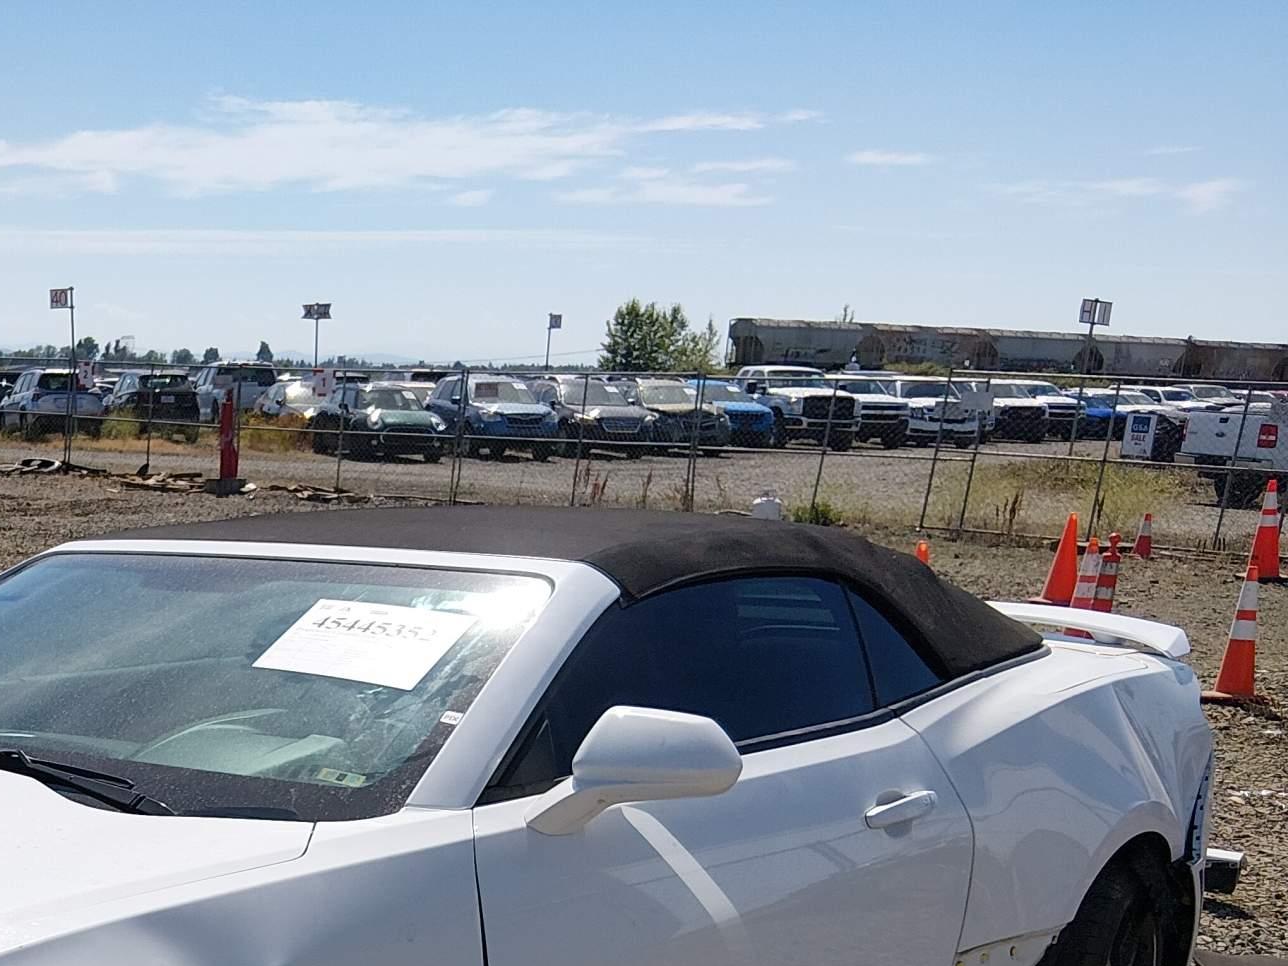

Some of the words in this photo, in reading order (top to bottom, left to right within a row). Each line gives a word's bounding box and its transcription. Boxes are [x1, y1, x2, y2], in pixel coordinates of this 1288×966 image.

[51, 290, 67, 307] 40
[1132, 424, 1148, 432] GSA
[312, 616, 437, 642] 45445352
